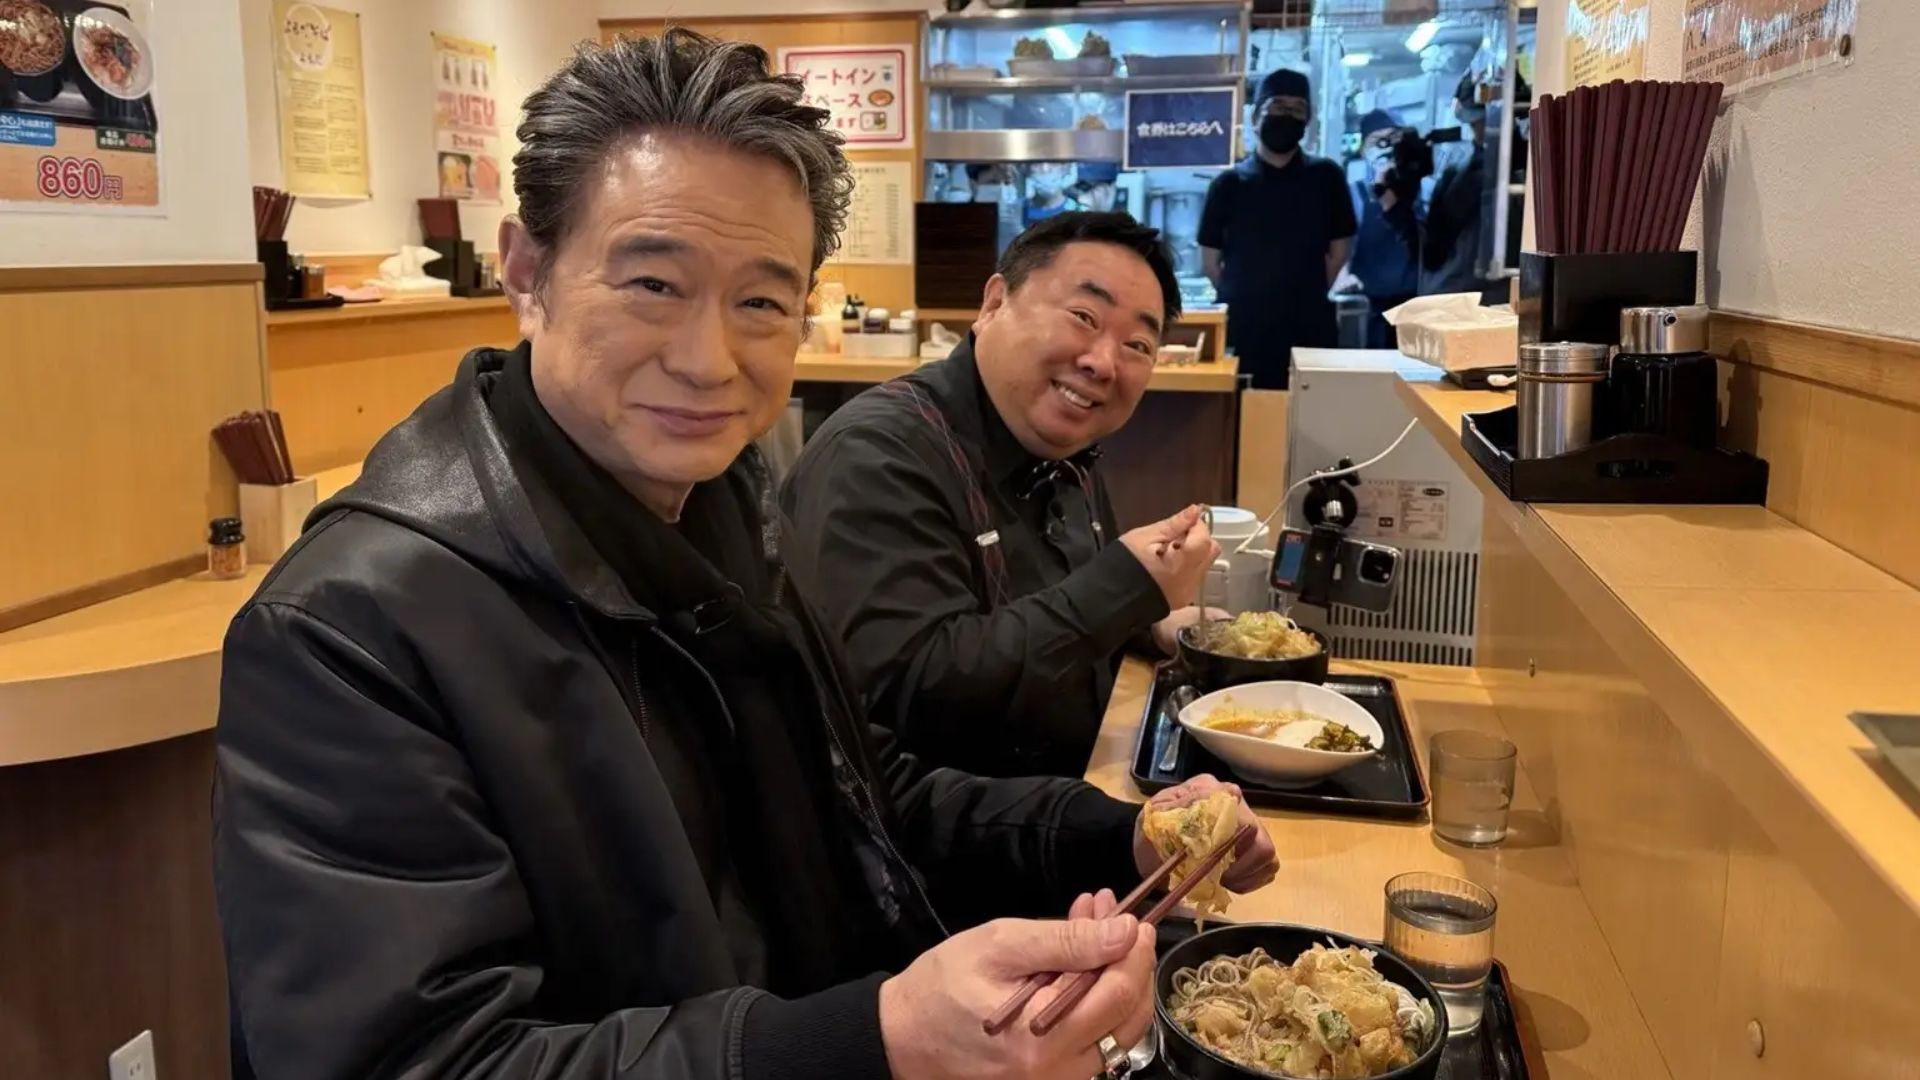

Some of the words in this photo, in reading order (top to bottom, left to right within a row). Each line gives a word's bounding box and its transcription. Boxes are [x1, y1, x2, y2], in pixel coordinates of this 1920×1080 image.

[801, 68, 876, 86] イートイン
[1136, 120, 1224, 138] 食券はこちらへ
